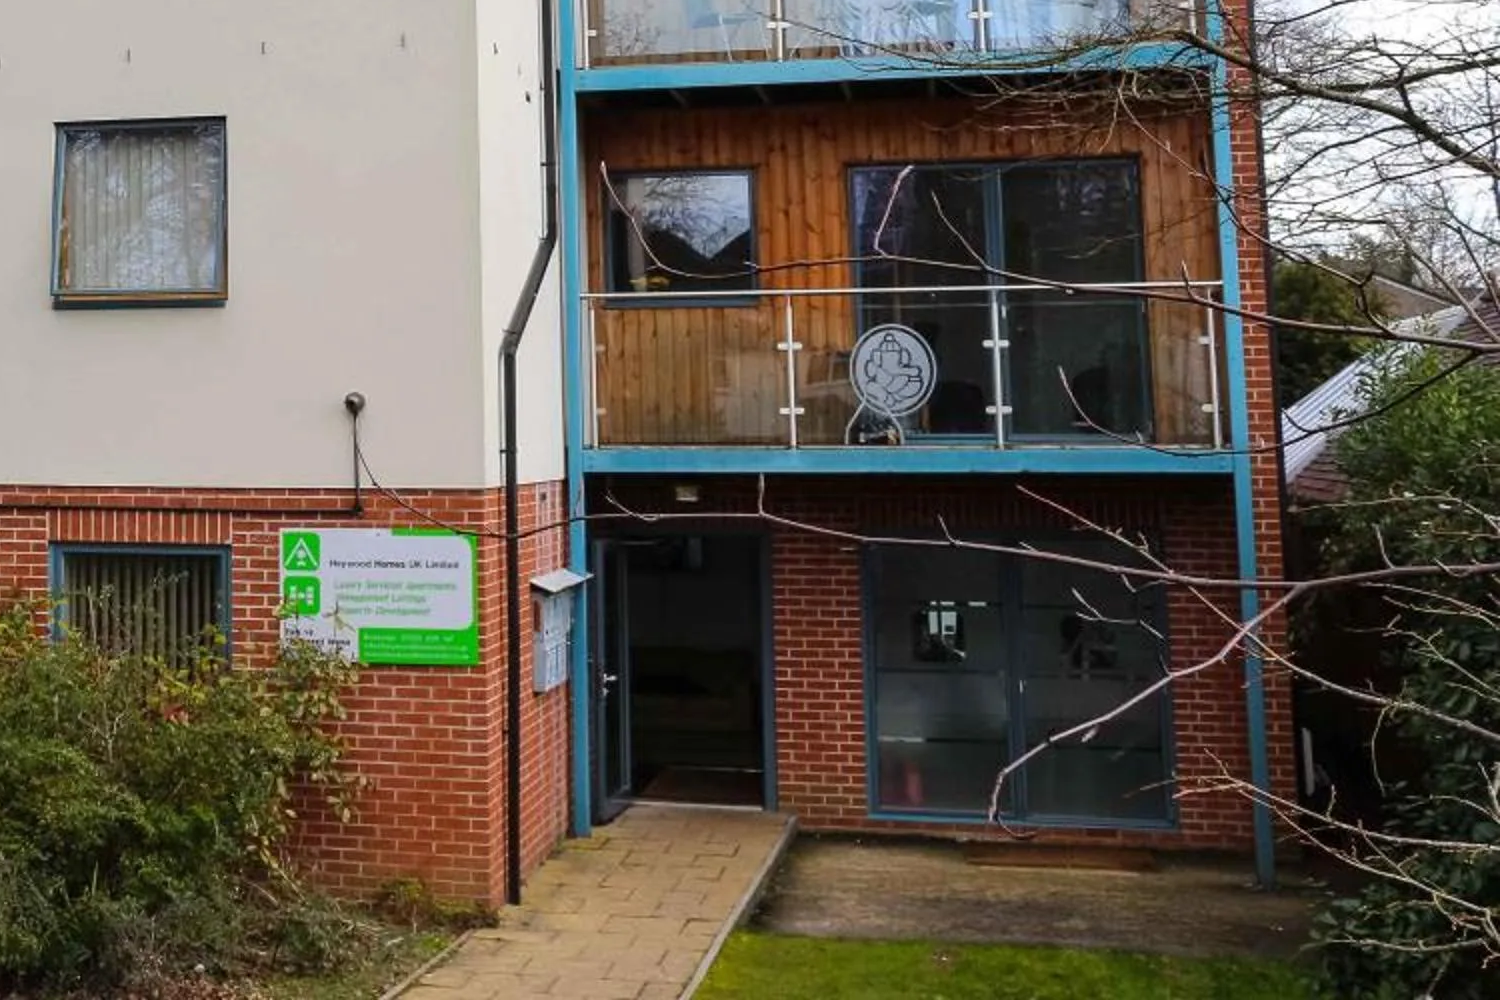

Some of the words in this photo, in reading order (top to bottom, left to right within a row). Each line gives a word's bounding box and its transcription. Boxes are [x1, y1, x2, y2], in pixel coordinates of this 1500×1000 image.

[373, 559, 405, 569] Homes
[408, 559, 423, 569] UK
[425, 559, 459, 569] Limited
